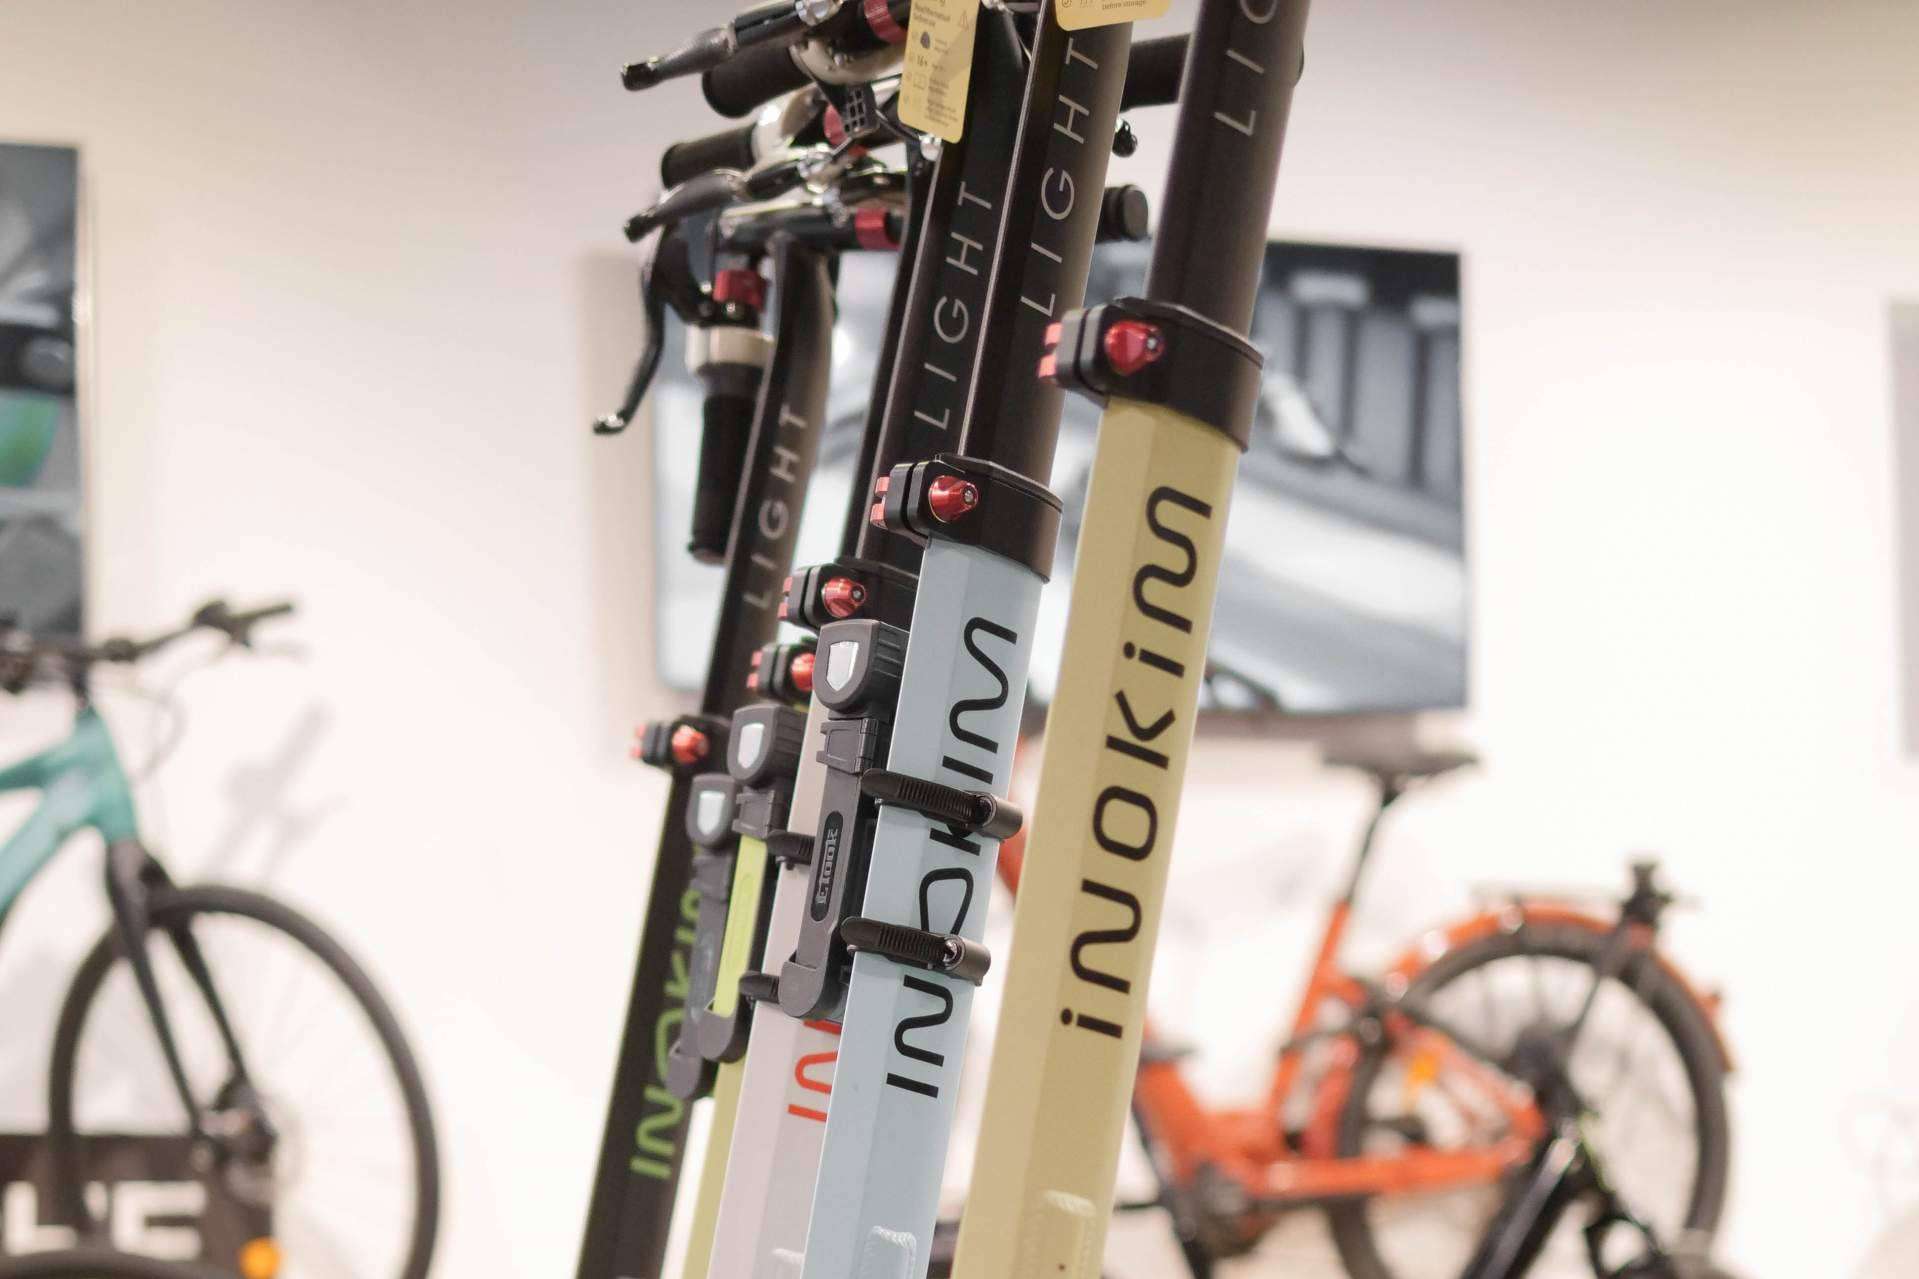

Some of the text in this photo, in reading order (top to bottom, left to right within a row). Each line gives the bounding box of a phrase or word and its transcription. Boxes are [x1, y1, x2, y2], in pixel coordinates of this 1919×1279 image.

[1020, 37, 1099, 317] LIGHT
[914, 181, 993, 430] LIGHT
[742, 403, 808, 610] LIGHT
